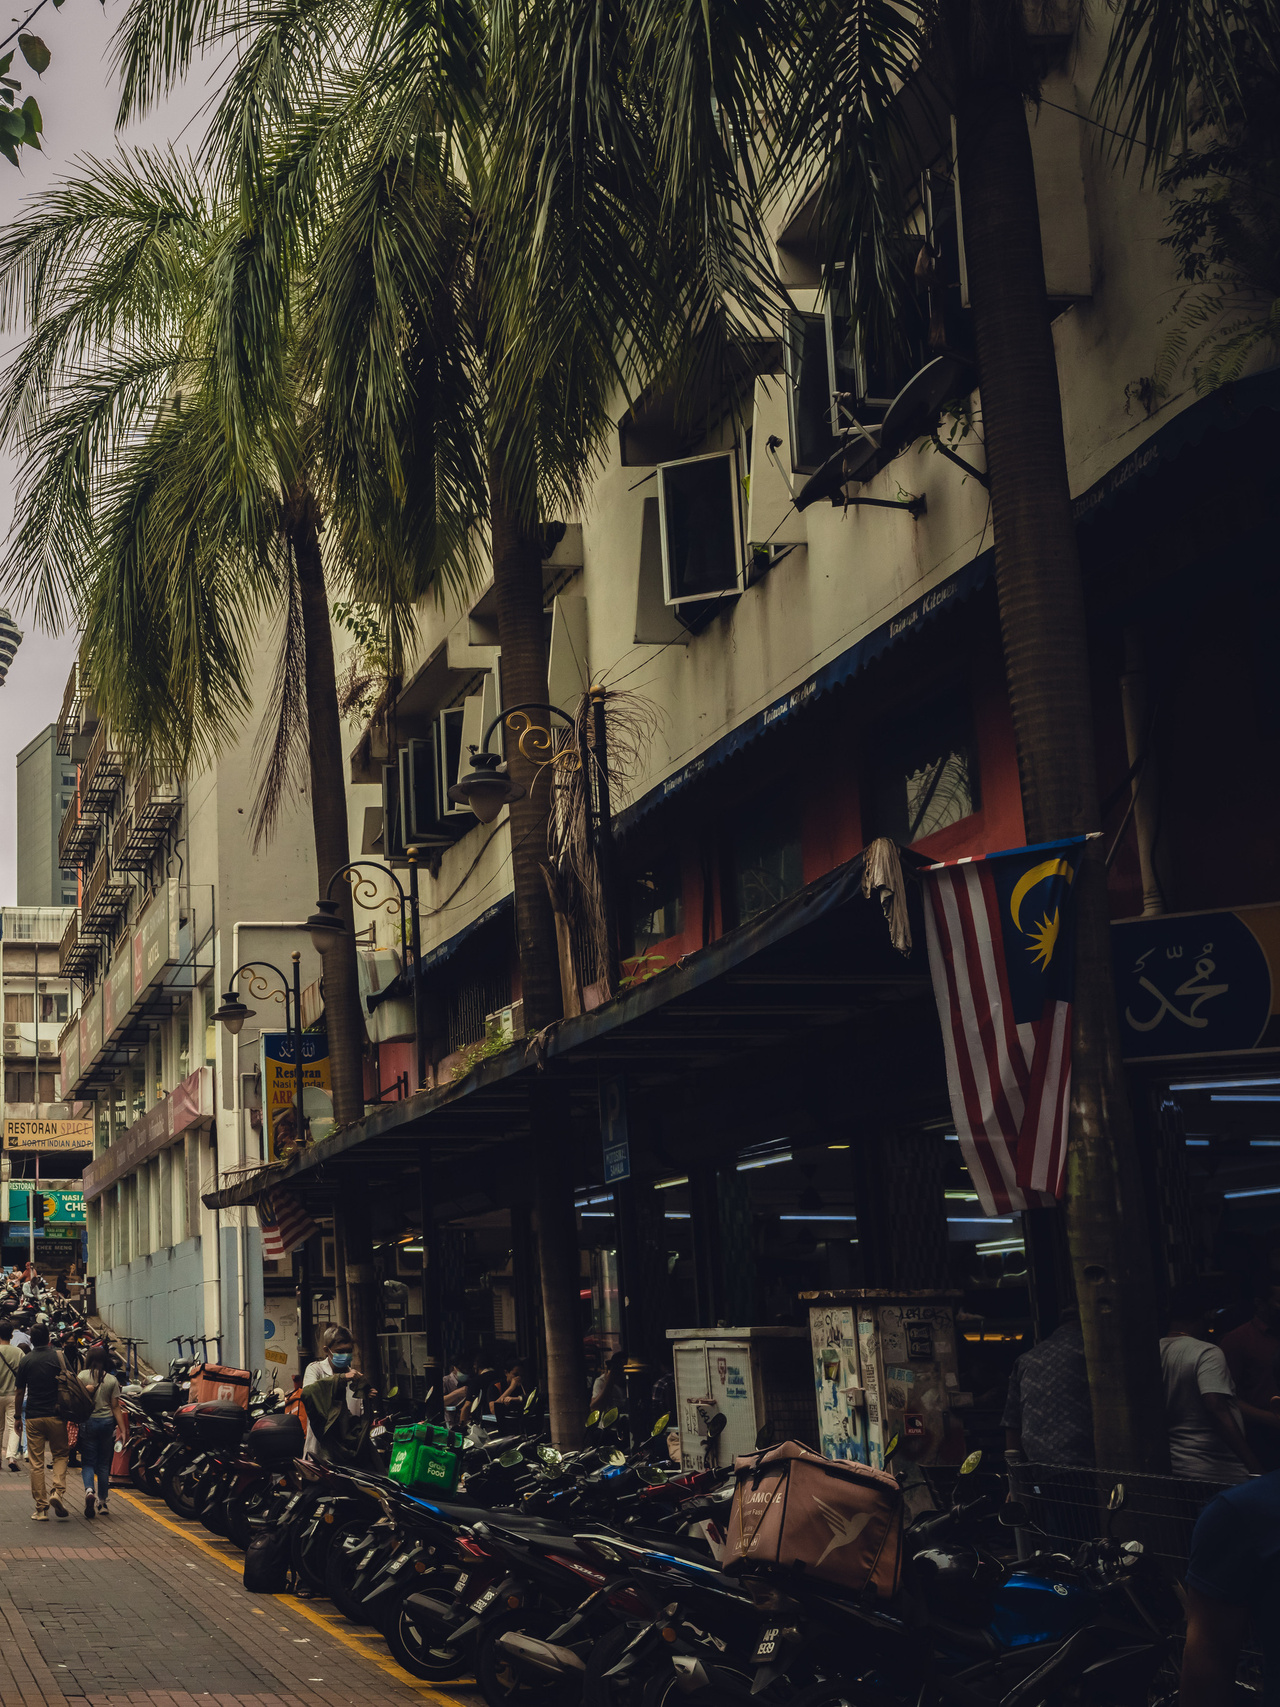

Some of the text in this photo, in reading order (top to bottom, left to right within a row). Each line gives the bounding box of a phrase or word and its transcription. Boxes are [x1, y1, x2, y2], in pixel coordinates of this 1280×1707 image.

[272, 1080, 326, 1089] Nasi Kndar
[8, 1122, 89, 1135] RESTORAN SPICE
[9, 1182, 35, 1190] RESTORAN
[266, 1351, 285, 1362] OPEN
[428, 1460, 446, 1471] Grab
[426, 1467, 446, 1478] Food
[763, 1628, 779, 1642] AHP
[757, 1642, 775, 1655] 1939
